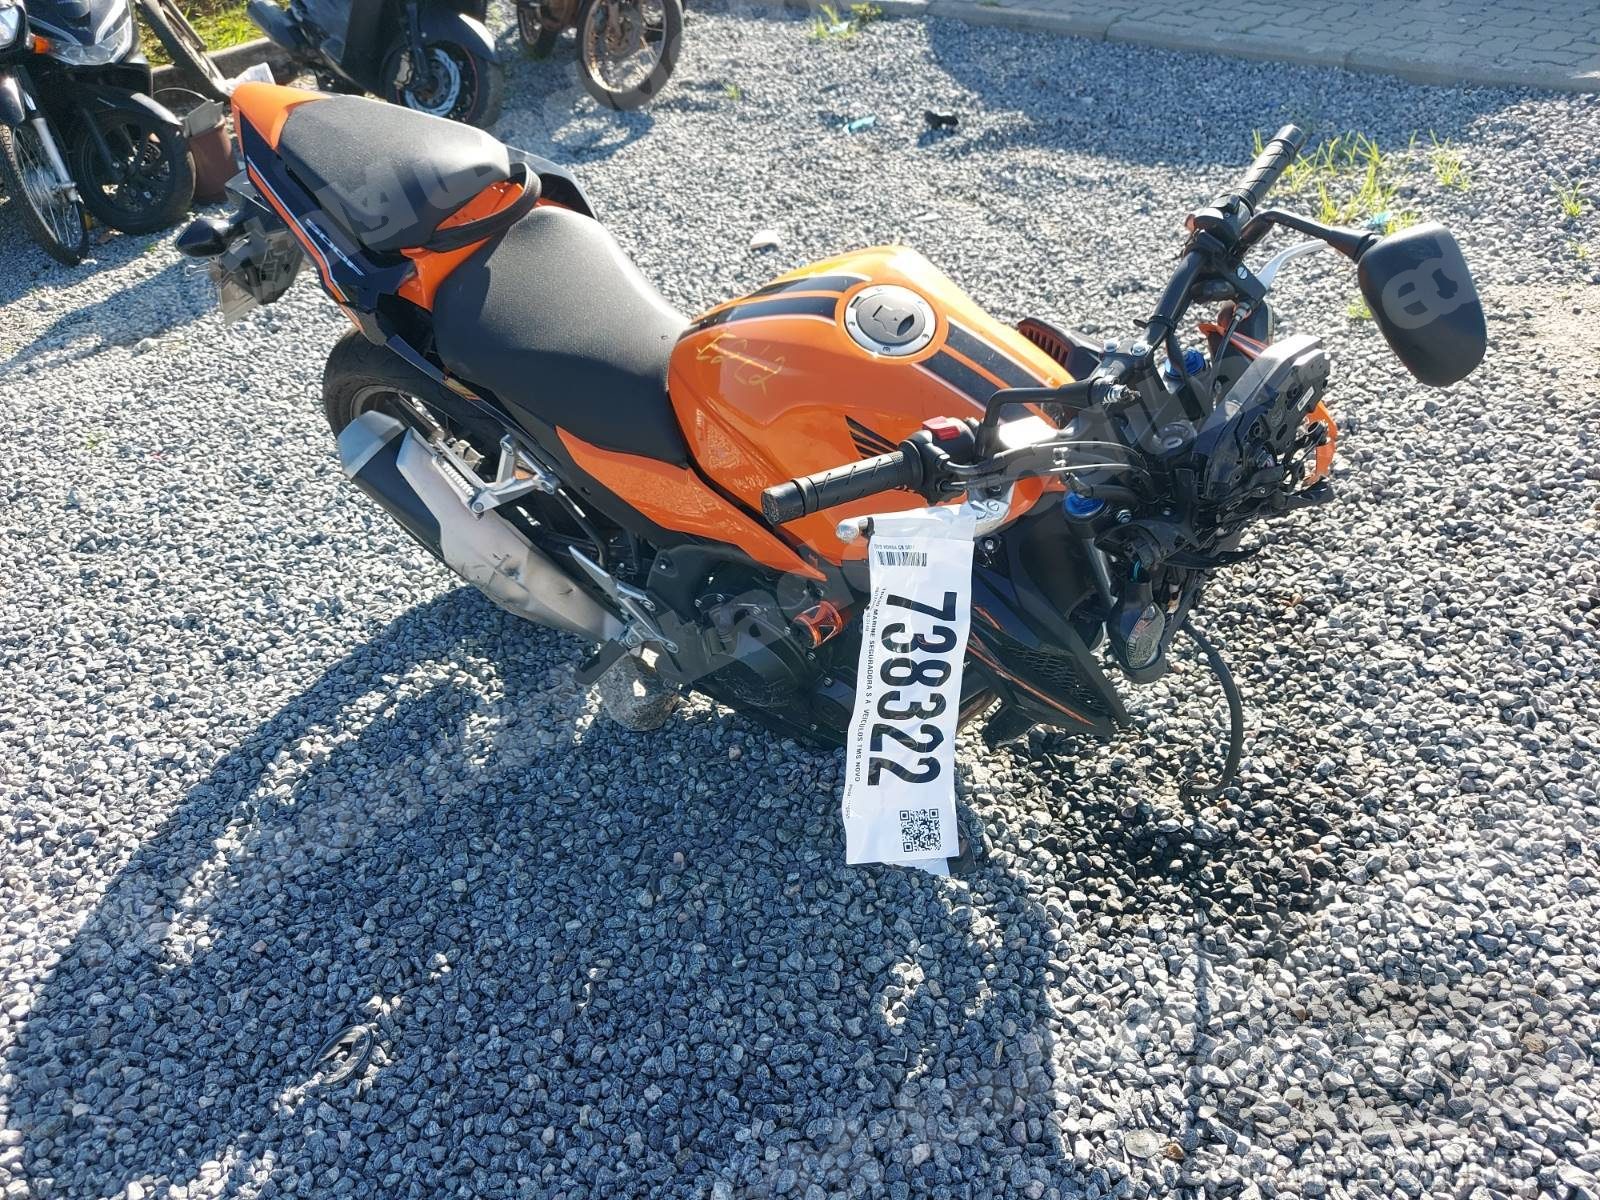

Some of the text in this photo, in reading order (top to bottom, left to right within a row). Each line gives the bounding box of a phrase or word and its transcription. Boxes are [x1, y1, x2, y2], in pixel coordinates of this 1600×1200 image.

[869, 608, 878, 638] MARINE
[866, 640, 875, 690] SEGURADORA
[867, 592, 958, 786] 738322
[857, 709, 869, 742] VEICULOS
